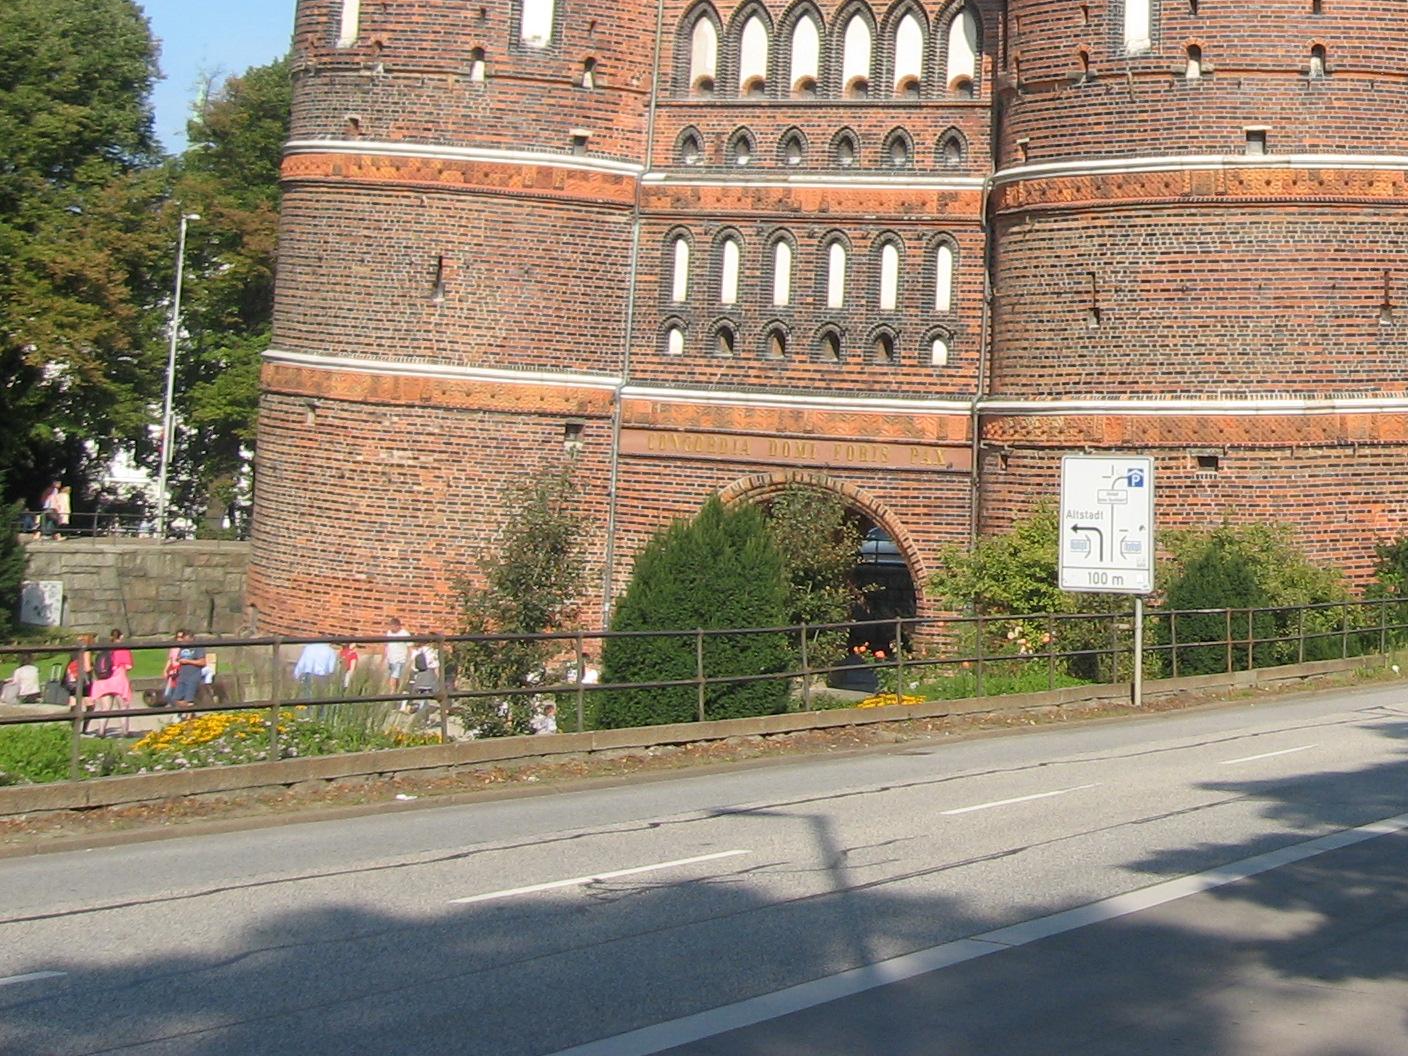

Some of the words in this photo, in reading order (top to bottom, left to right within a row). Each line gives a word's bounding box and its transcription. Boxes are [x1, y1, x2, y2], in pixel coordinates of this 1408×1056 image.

[910, 447, 946, 466] PAX
[1066, 510, 1104, 520] Altstadt
[1088, 572, 1108, 584] 100
[1112, 576, 1124, 585] m
